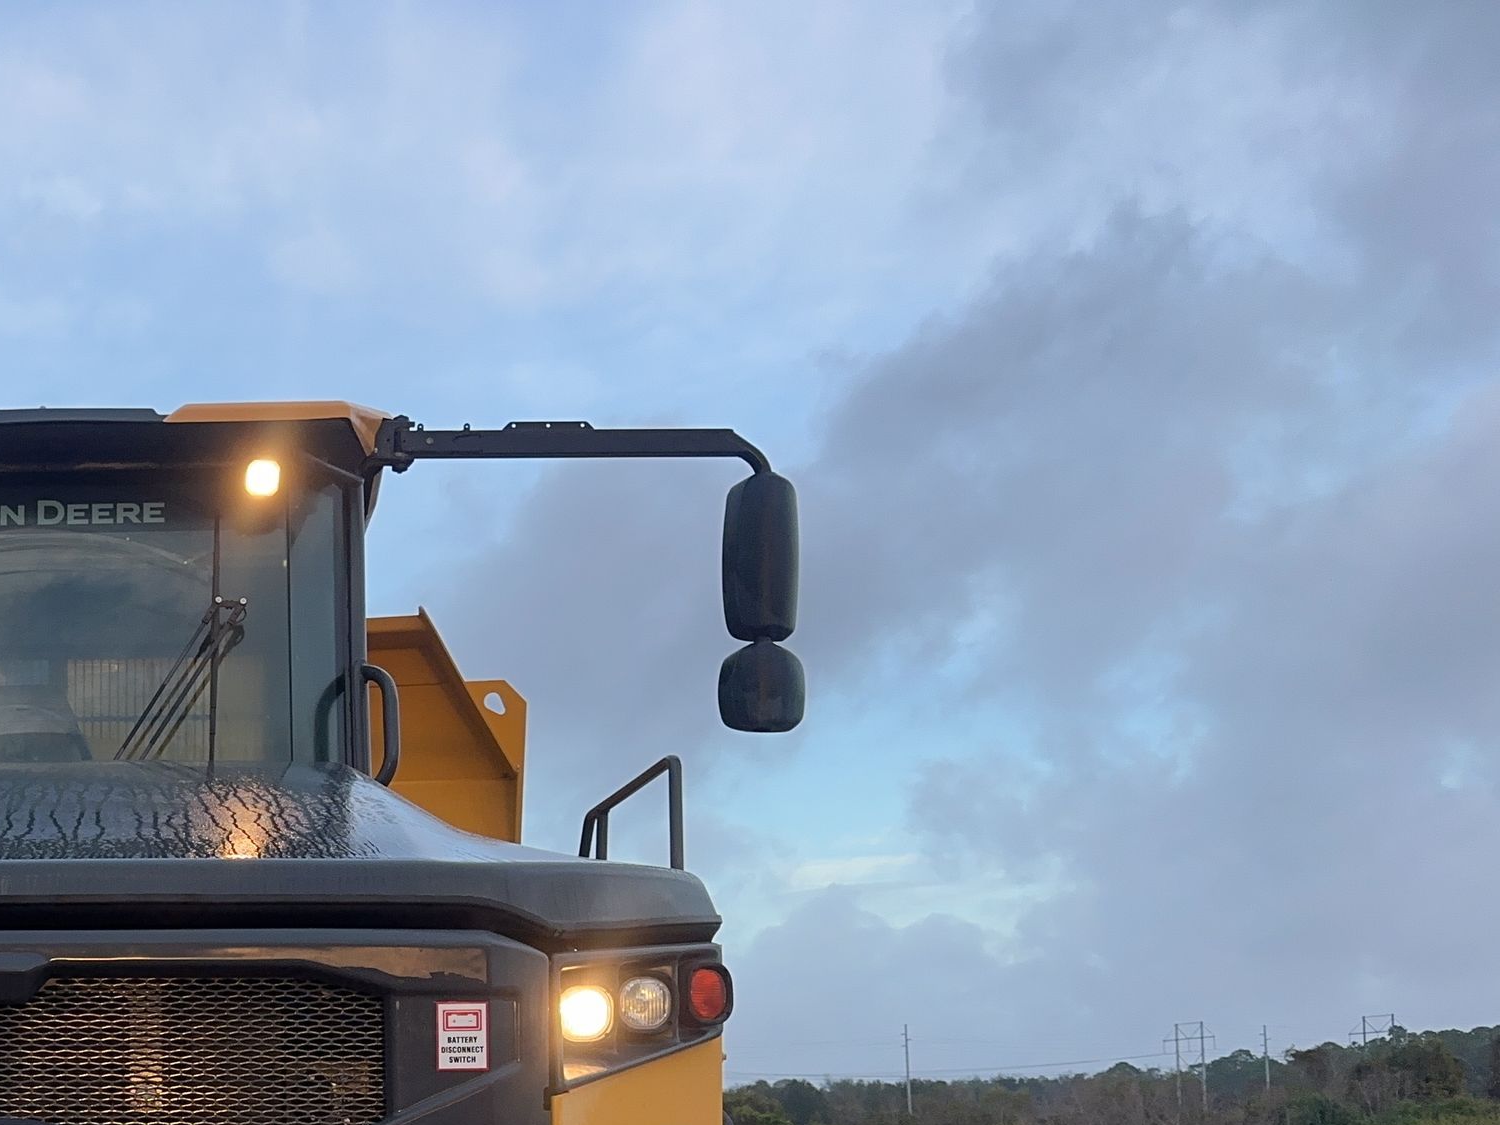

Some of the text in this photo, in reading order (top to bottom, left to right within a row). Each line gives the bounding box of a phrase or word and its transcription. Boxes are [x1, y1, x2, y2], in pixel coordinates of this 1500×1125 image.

[37, 500, 165, 526] DEERE
[447, 1036, 478, 1044] BATTERY
[441, 1046, 484, 1054] DISCONNECT
[449, 1056, 477, 1064] SWITCH
